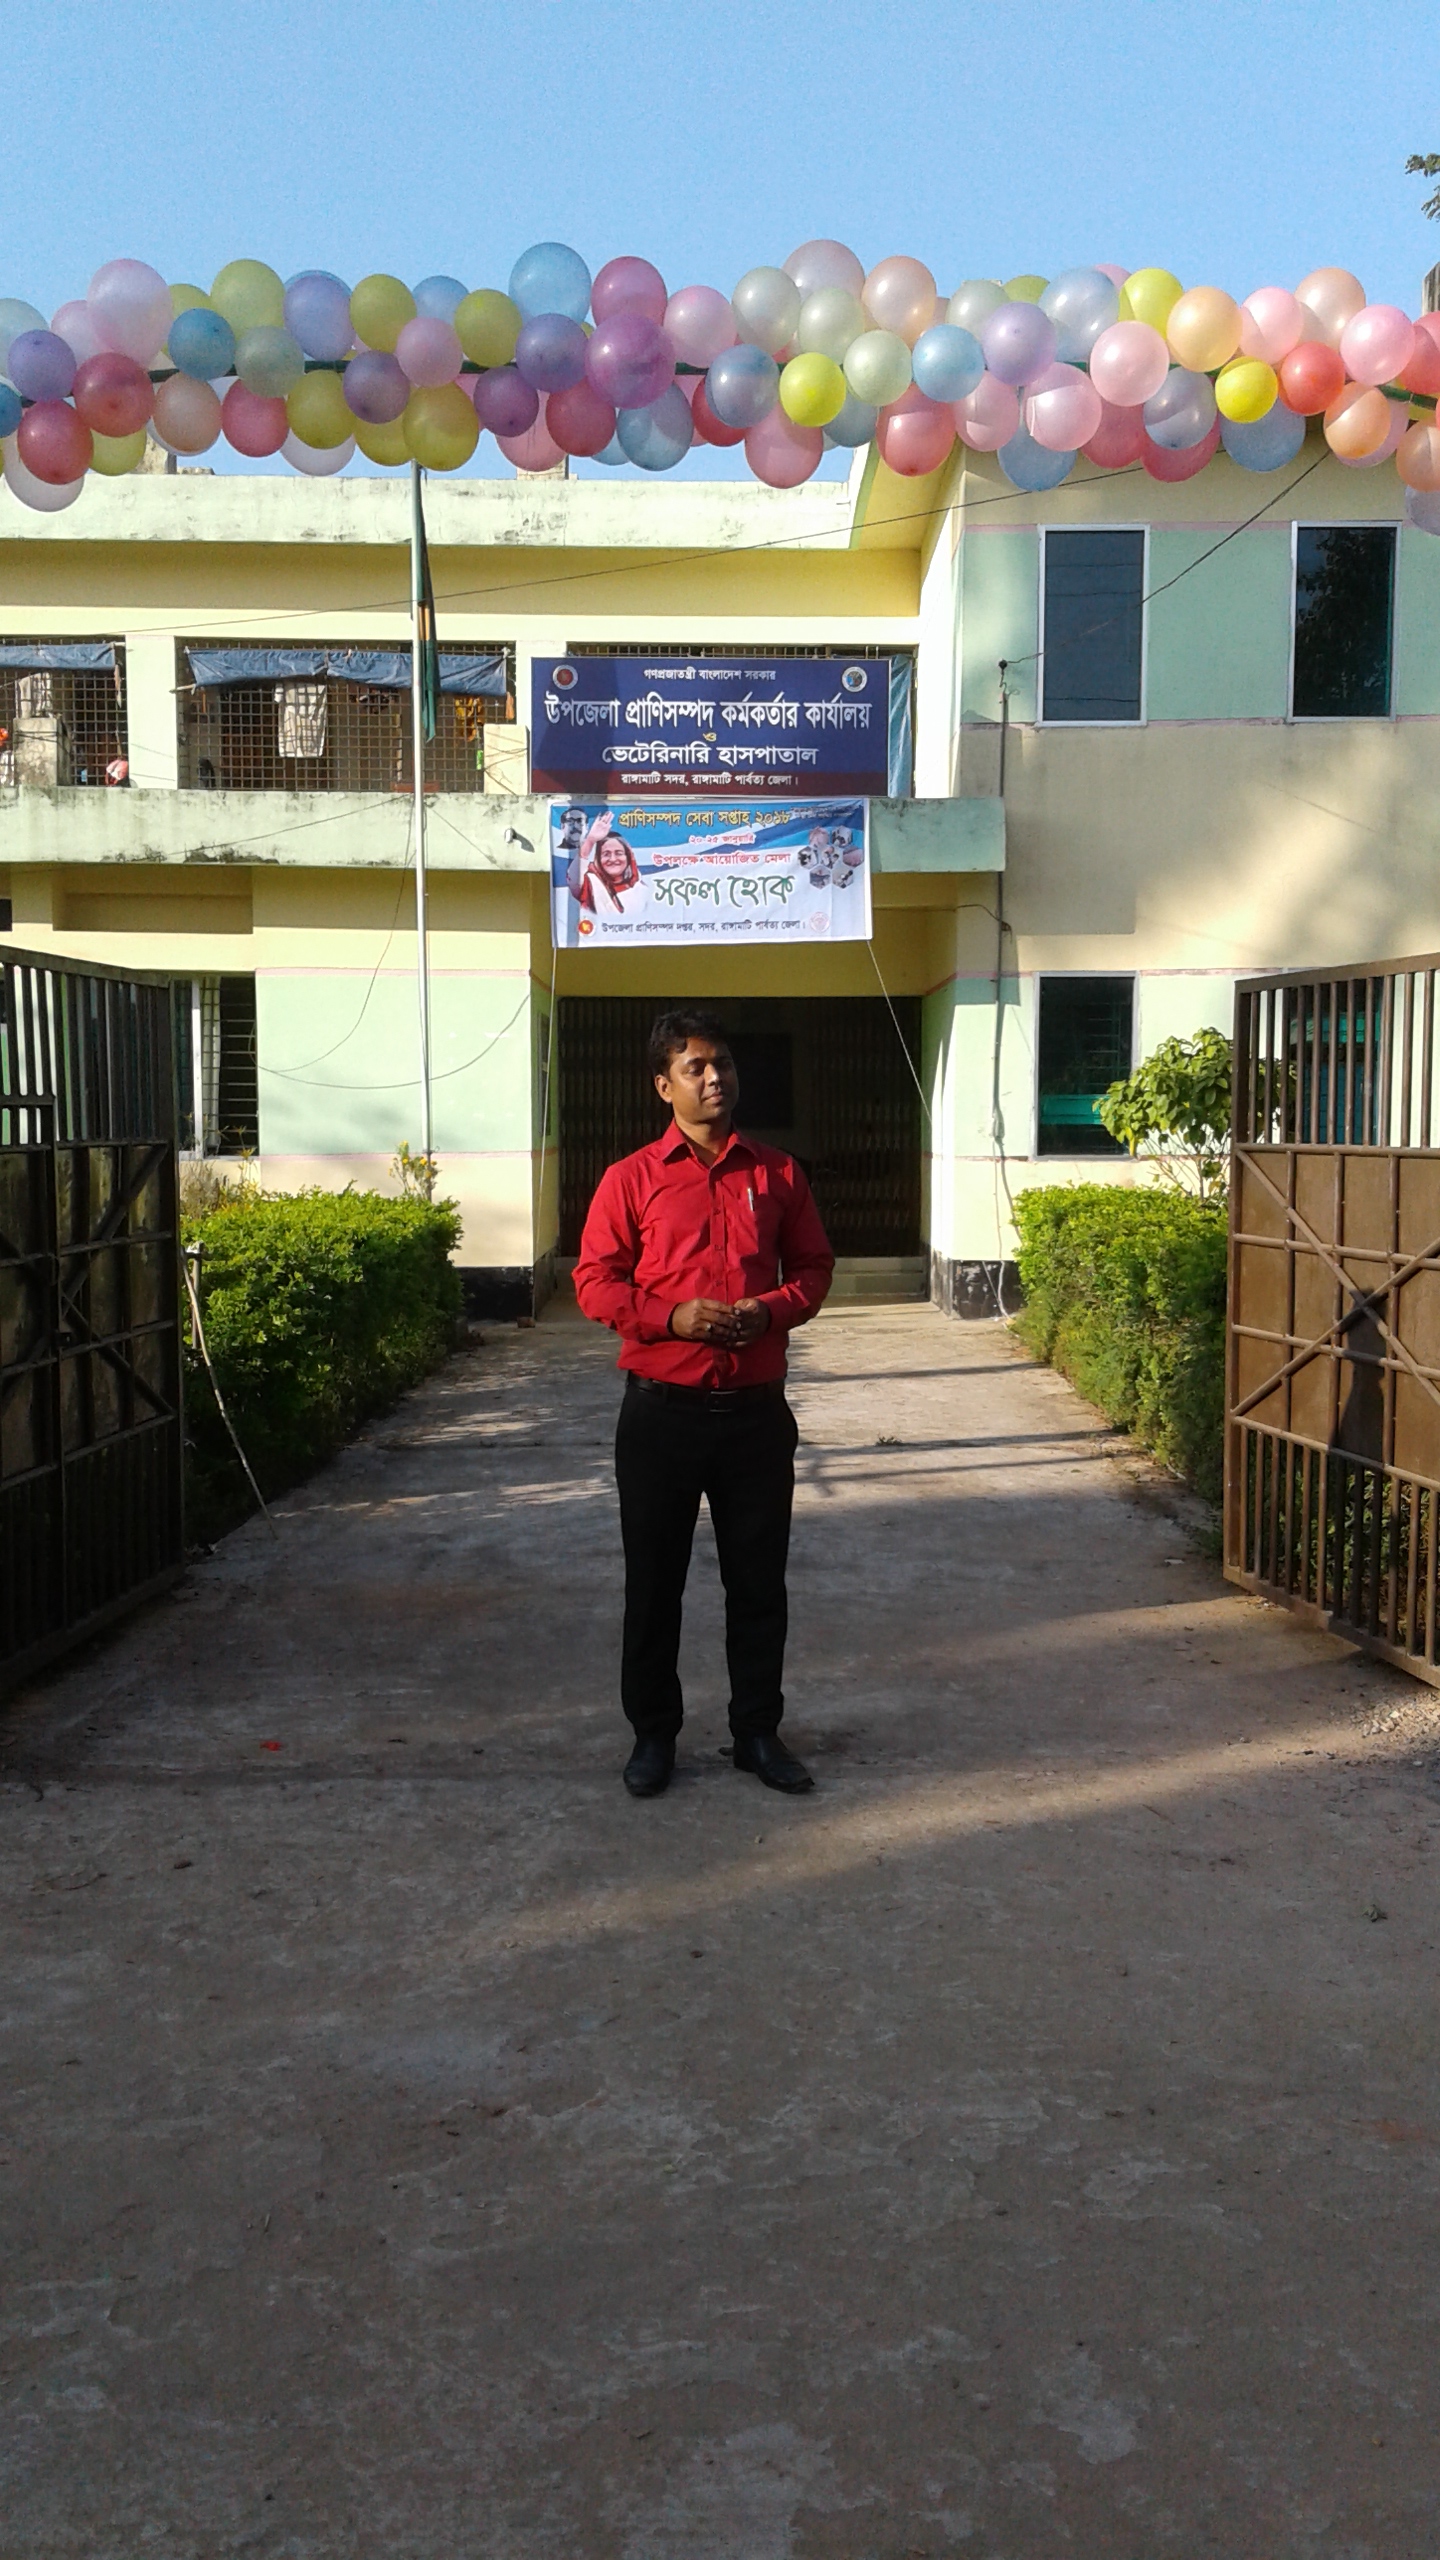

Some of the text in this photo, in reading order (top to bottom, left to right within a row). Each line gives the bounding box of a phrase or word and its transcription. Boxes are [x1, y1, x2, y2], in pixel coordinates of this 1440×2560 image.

[644, 665, 776, 681] গণপ্রজাতন্ত্রী বাংলাদেশ সরকার
[544, 690, 872, 730] উপজেলা প্রাণিসম্পদ কর্মকর্তার কার্যালয়
[703, 732, 717, 742] ও
[602, 740, 819, 767] ভেটেরিনারি হাসপাতাল
[621, 771, 661, 784] রাঙ্গামাটি
[664, 774, 689, 786] সদর,
[692, 771, 732, 785] রাঙ্গামাটি
[734, 772, 765, 785] পার্বত্য
[619, 808, 682, 828] প্রাণিসম্পদ
[686, 811, 714, 827] সেবা
[718, 808, 751, 828] সপ্তাহ
[652, 852, 791, 868] উপলক্ষে আয়োজিত মেলা
[654, 875, 795, 908] সফল হোক
[602, 922, 633, 933] উপজেলা
[635, 921, 674, 933] প্রাণিসম্পদ
